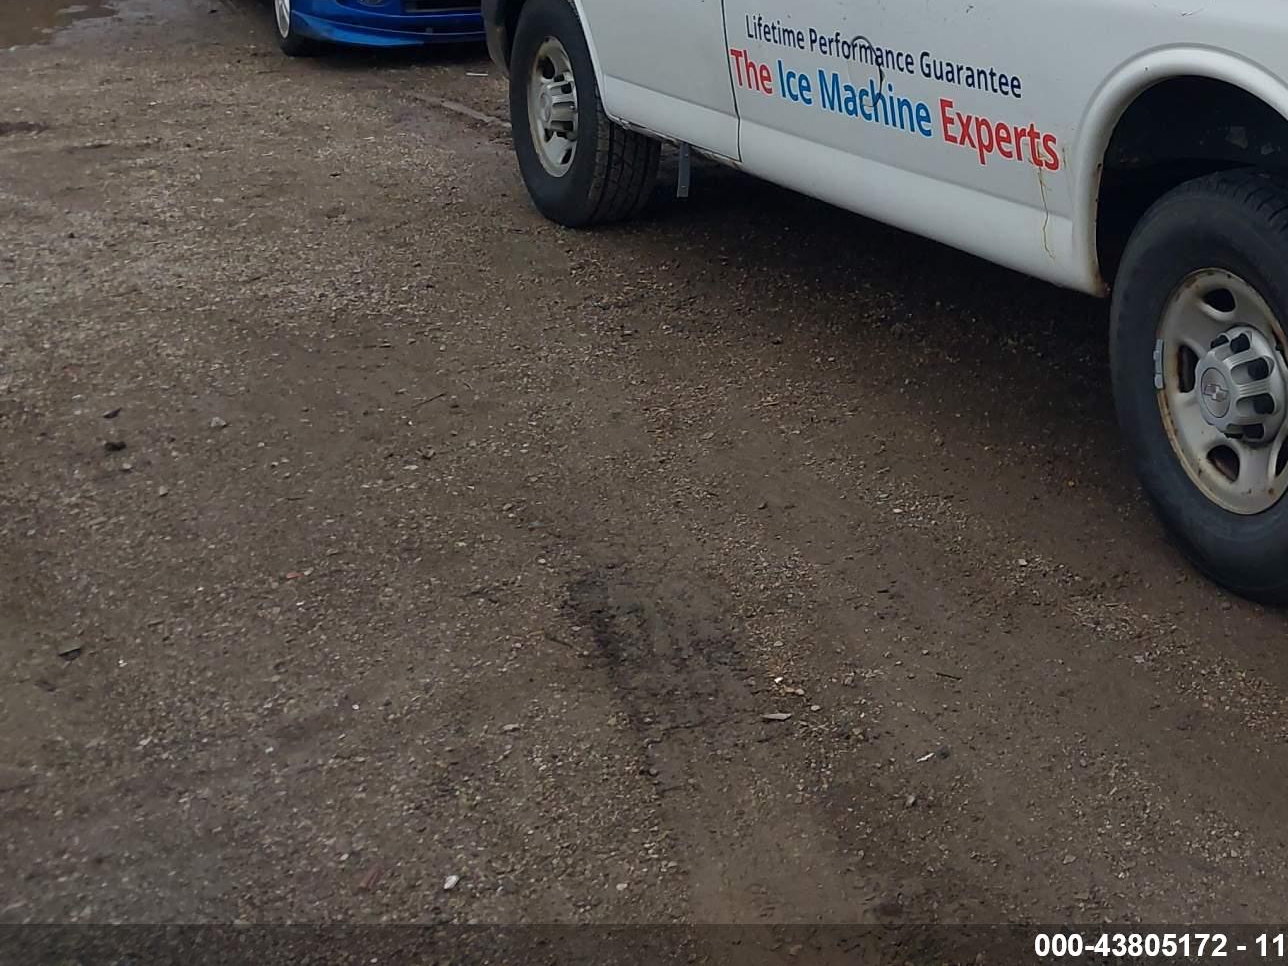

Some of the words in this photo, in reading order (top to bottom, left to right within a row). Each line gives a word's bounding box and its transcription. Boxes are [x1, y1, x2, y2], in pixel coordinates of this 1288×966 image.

[745, 15, 805, 51] Lifetime
[808, 28, 915, 75] Performance
[920, 50, 1022, 99] Guarantee
[730, 48, 774, 95] The
[778, 60, 813, 105] Ice
[818, 69, 933, 137] Machine
[940, 98, 1060, 171] Experts
